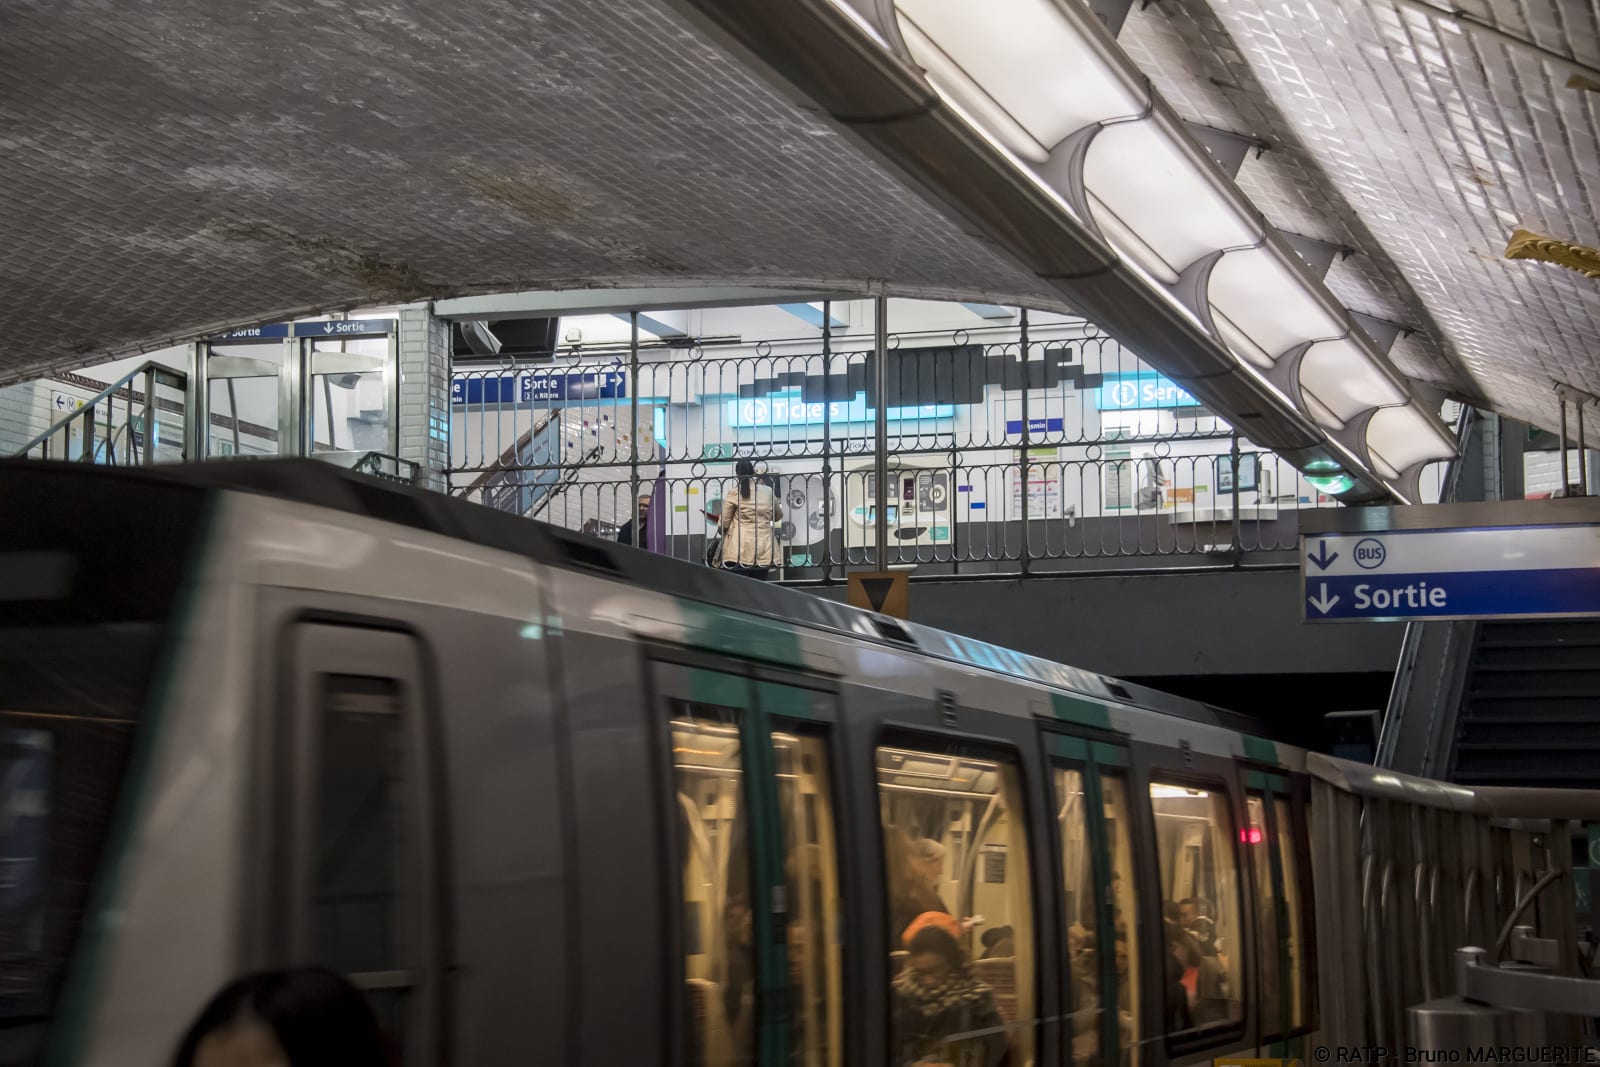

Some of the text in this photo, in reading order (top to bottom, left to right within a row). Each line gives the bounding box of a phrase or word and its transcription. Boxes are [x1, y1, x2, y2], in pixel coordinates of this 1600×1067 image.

[336, 322, 366, 333] Sortie
[523, 378, 558, 390] Sorte
[772, 401, 840, 419] Tickes
[1357, 547, 1382, 560] BUS
[1353, 582, 1447, 610] Sortie
